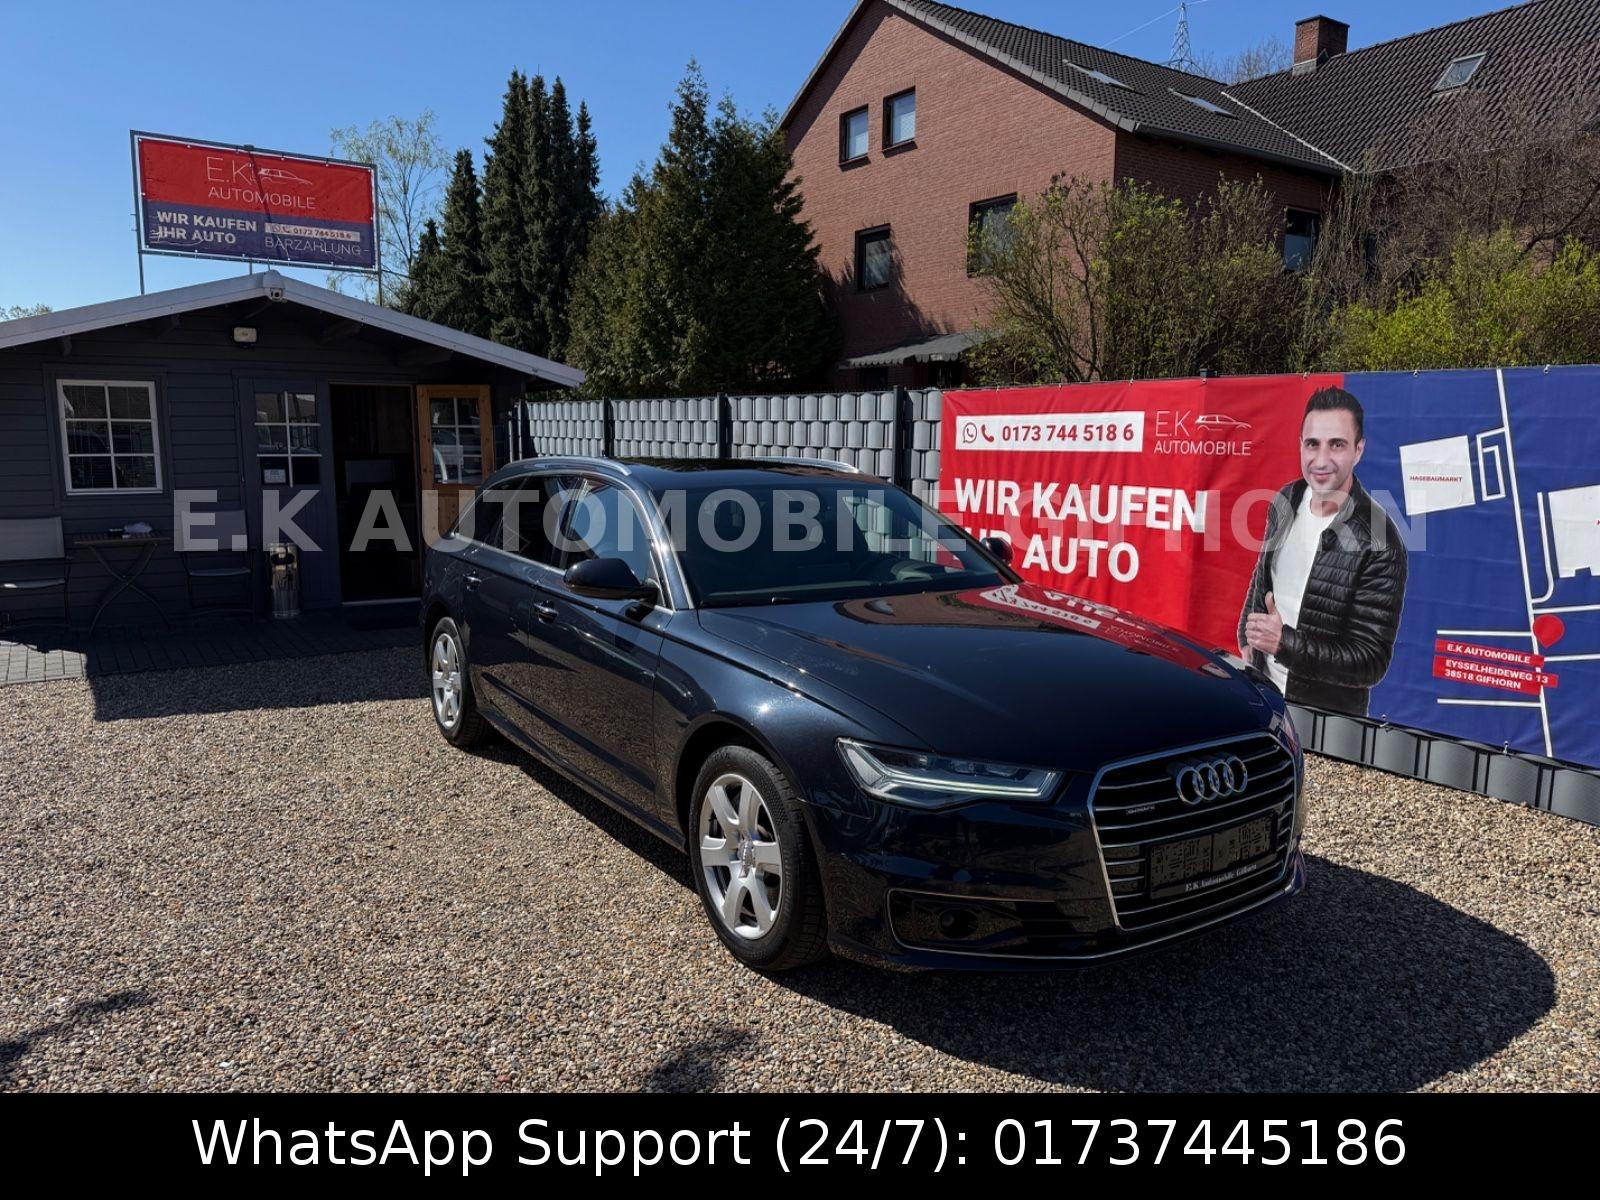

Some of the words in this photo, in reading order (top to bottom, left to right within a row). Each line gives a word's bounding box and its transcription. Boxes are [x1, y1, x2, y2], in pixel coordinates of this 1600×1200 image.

[207, 186, 317, 210] AUTOMOBILE
[156, 210, 189, 225] WIR
[193, 214, 257, 232] KAUFEN
[158, 225, 187, 240] IHR
[191, 229, 236, 244] AUTO
[265, 236, 361, 256] BARZAHLUNG
[1002, 425, 1041, 442] 0173
[1046, 424, 1078, 442] 744
[1083, 424, 1117, 442] 518
[1123, 423, 1134, 441] 6
[1155, 409, 1192, 437] E.K
[1153, 440, 1252, 456] AUTOMOBILE
[1410, 475, 1463, 483] HAGEBAUMARKT
[954, 477, 1021, 517] WIR
[1032, 481, 1208, 534] KAUFEN
[1021, 533, 1140, 584] AUTO
[1463, 646, 1531, 664] AUTOMOBILE
[1444, 668, 1474, 681] 38518
[1475, 674, 1521, 689] GIFHORN
[1445, 659, 1533, 681] EYSSELHEIDEWEG
[1536, 675, 1549, 684] 13
